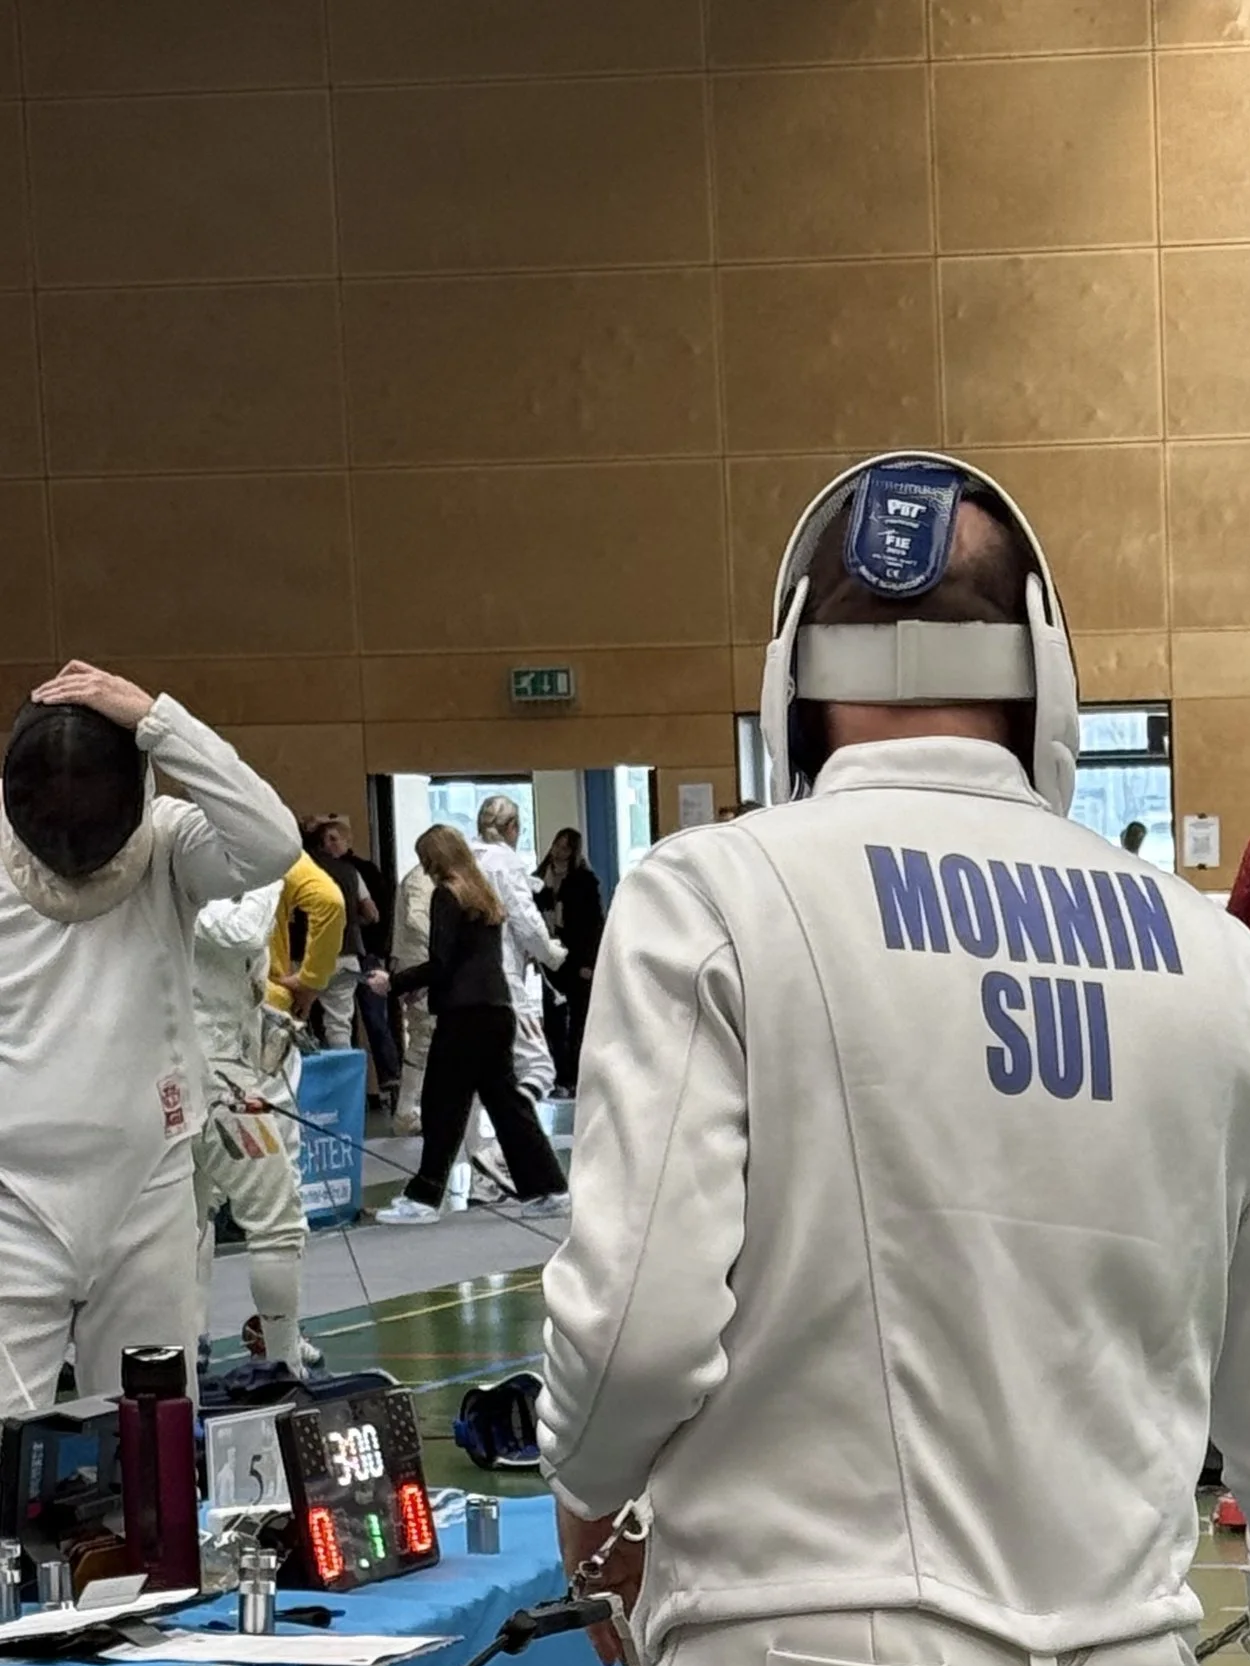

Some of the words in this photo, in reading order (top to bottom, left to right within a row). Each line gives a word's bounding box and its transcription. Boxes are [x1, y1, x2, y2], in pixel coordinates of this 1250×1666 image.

[885, 535, 911, 550] FIE
[865, 845, 1184, 975] MONNIN
[982, 971, 1113, 1101] SUI
[249, 1453, 265, 1506] 5
[329, 1424, 385, 1486] 3:00
[308, 1506, 344, 1583] 0
[397, 1482, 433, 1553] 0
